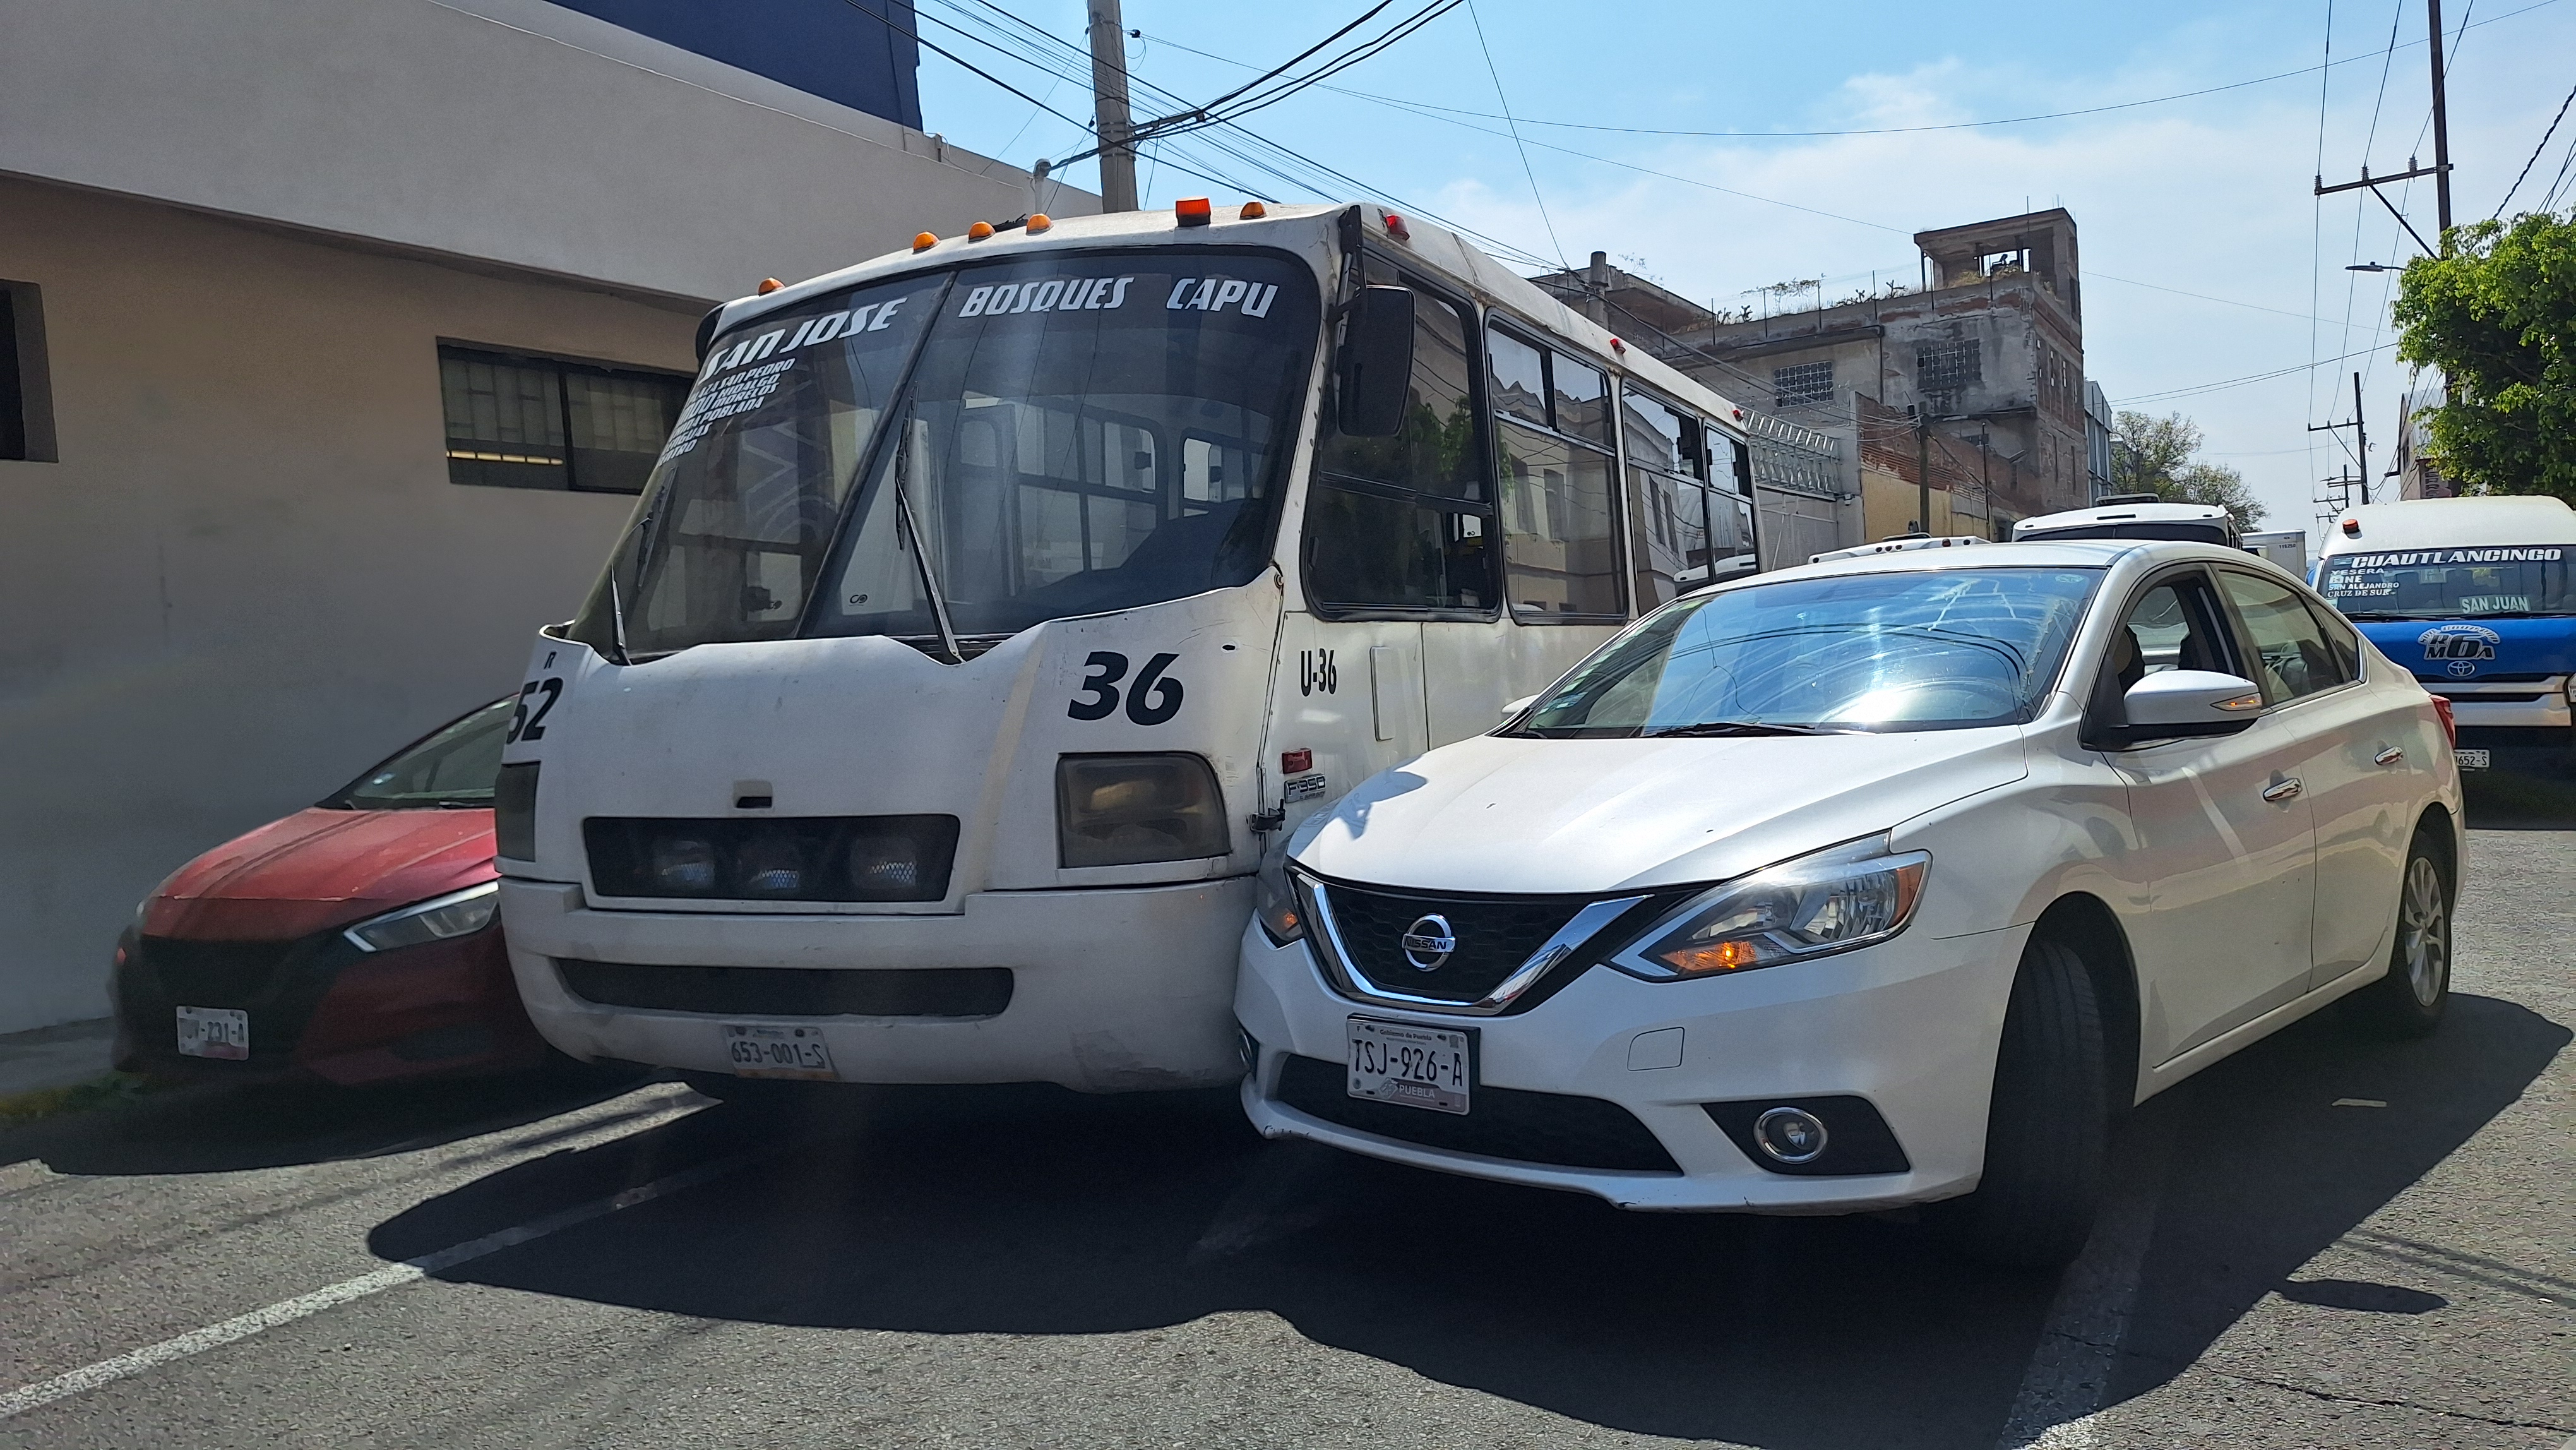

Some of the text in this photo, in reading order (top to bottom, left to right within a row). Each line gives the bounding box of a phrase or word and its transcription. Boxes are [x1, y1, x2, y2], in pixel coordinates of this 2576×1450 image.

[958, 277, 1279, 318] BOSQUES CAPU
[697, 297, 908, 385] SAN JOSE
[717, 371, 747, 390] SAN
[746, 358, 796, 380] PEDRO
[717, 373, 781, 399] HIDALGO
[700, 396, 765, 424] POBLANA
[711, 382, 780, 410] MORELOS
[2351, 549, 2561, 568] CUAUTLANCINGO
[2462, 596, 2529, 613] SAN JUAN
[544, 651, 558, 670] R
[1301, 648, 1337, 697] U-36
[1067, 650, 1184, 726] 36
[506, 678, 564, 745] 52
[1405, 936, 1446, 949] NISSAN
[731, 1041, 825, 1069] 653-001-S
[1352, 1038, 1462, 1086] TSJ-926-A
[1399, 1084, 1435, 1098] PUEBLA
